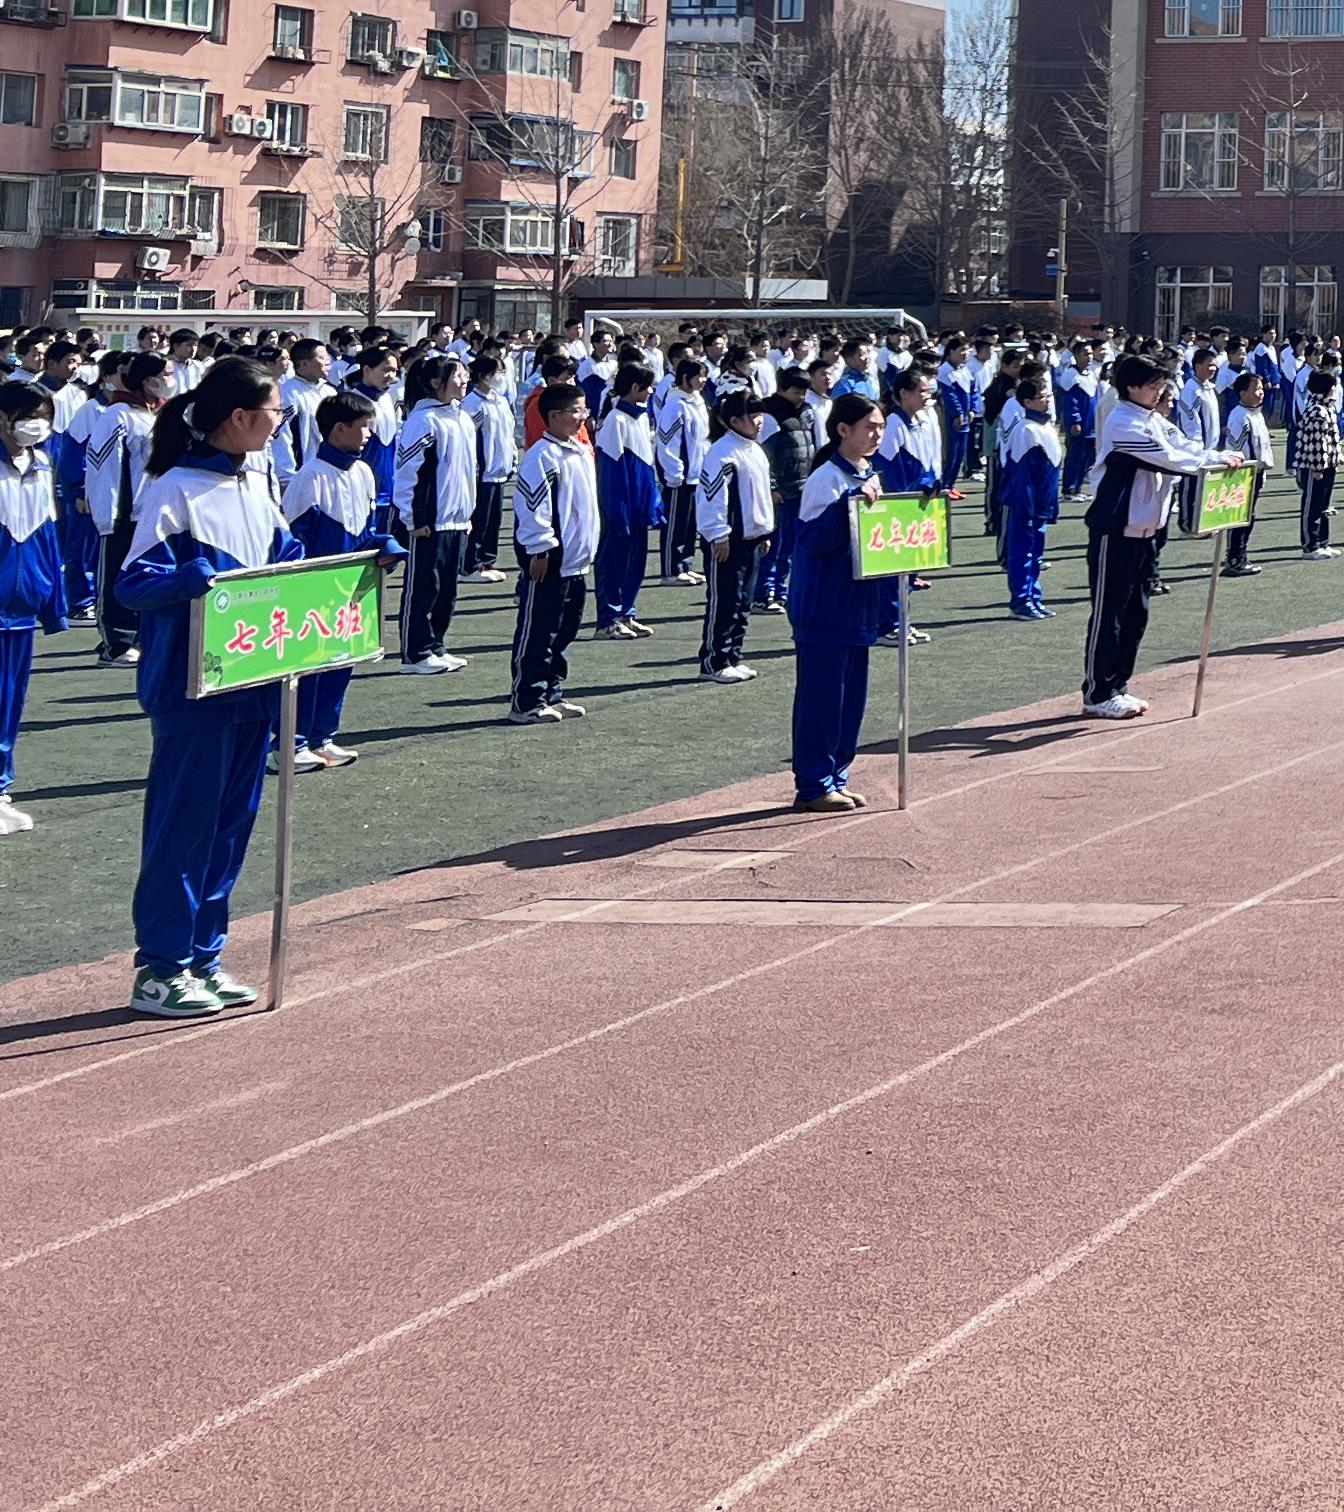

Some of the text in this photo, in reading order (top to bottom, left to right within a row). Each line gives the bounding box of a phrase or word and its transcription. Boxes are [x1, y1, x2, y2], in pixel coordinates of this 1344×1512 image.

[867, 517, 938, 554] 七年七班
[225, 600, 363, 660] 七年八班
